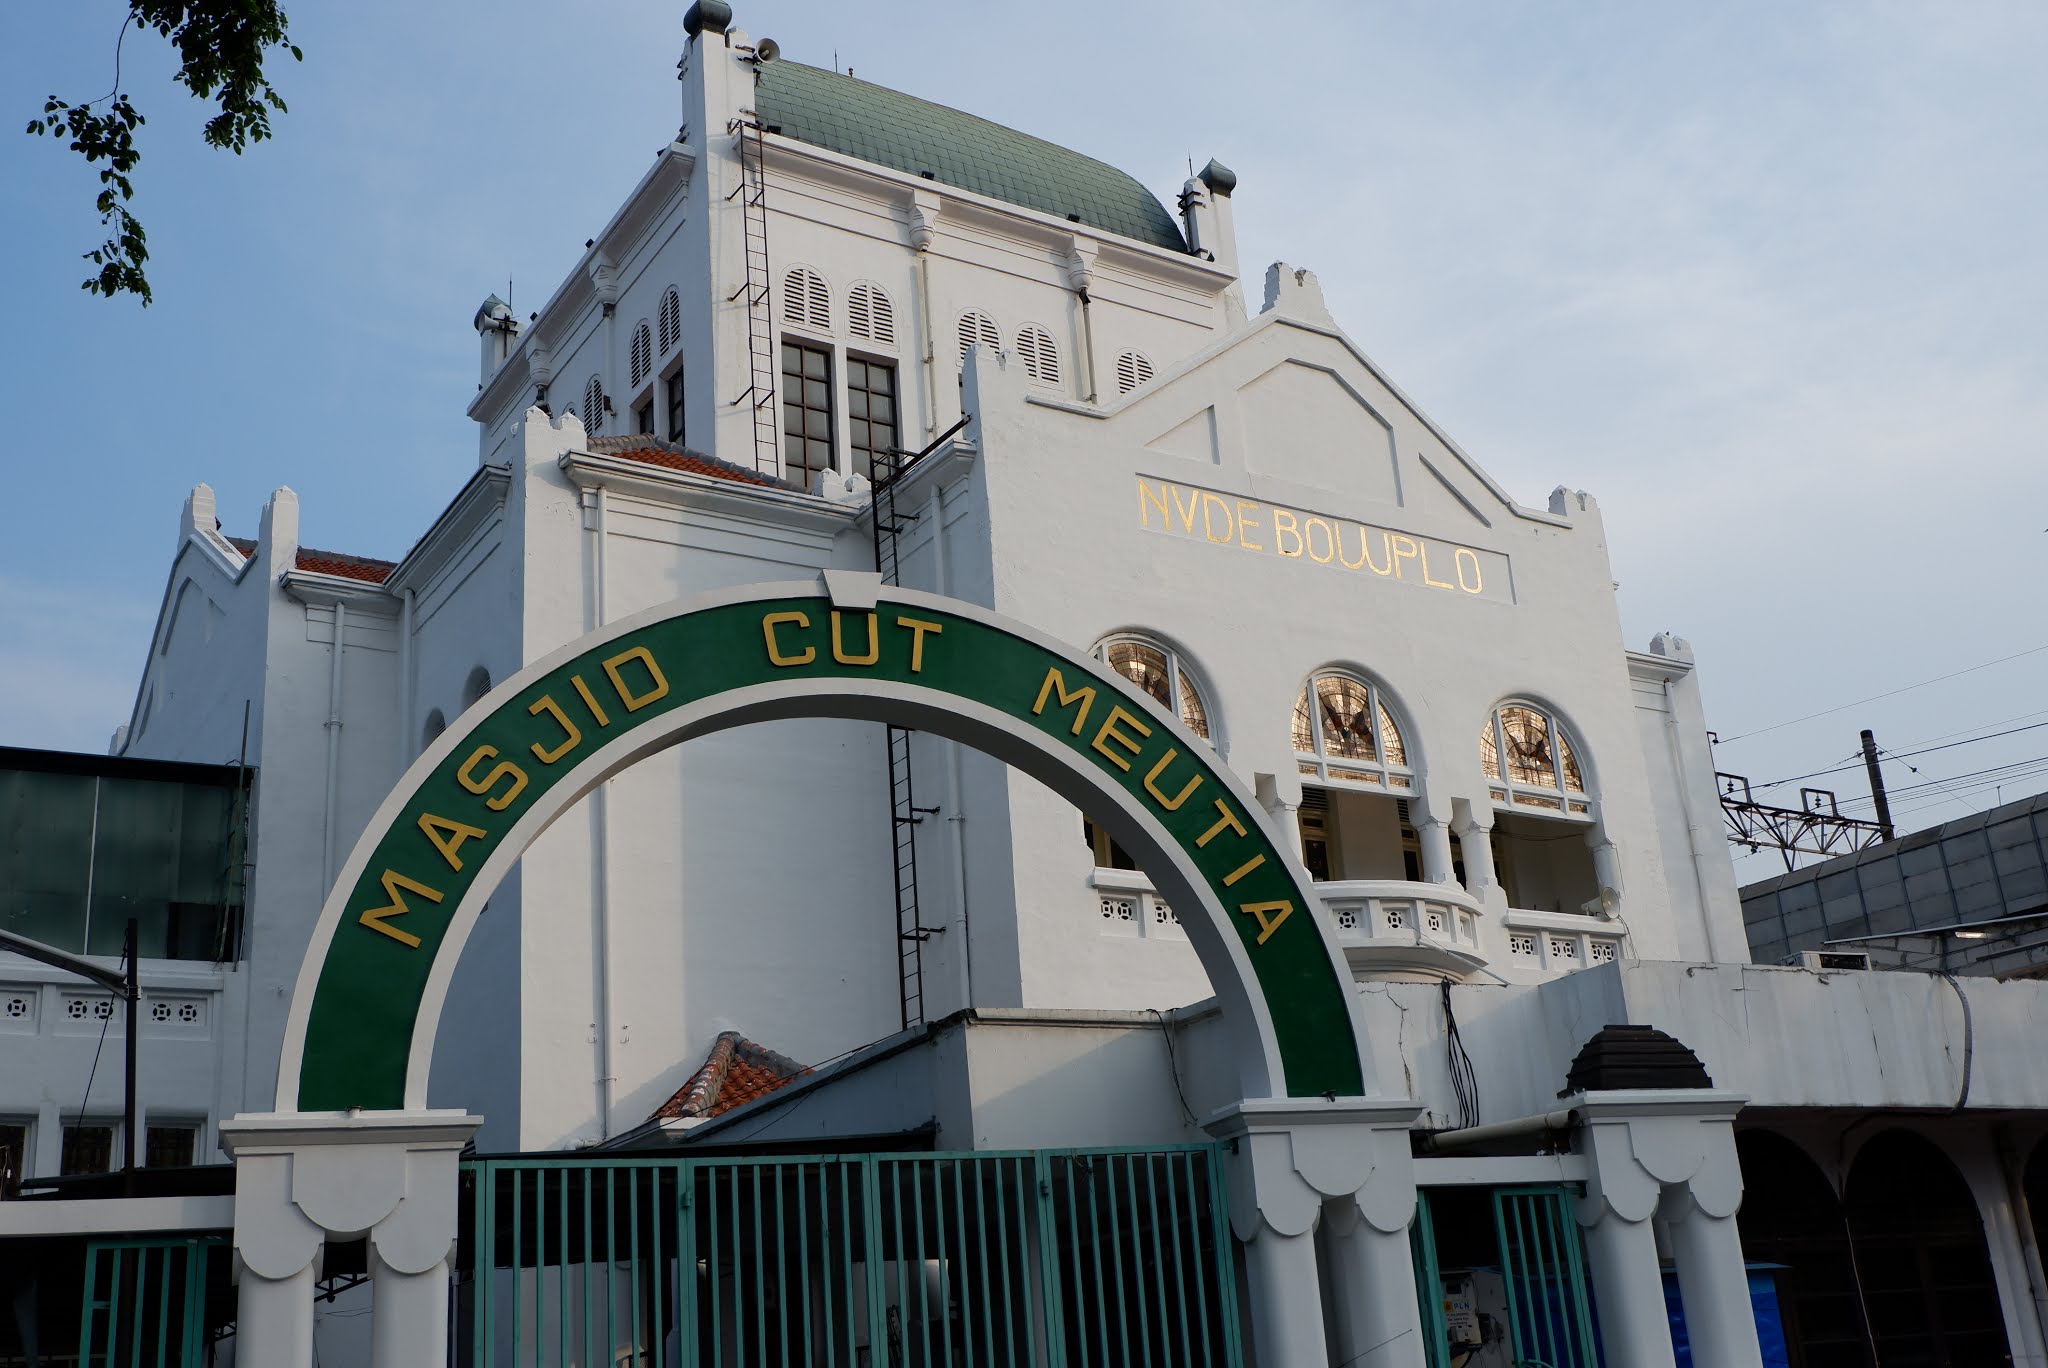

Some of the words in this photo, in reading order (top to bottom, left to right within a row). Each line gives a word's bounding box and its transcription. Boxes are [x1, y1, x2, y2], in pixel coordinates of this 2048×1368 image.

[359, 646, 669, 948] MASJID
[763, 610, 943, 672] CUT
[1033, 667, 1294, 946] MEUTIA
